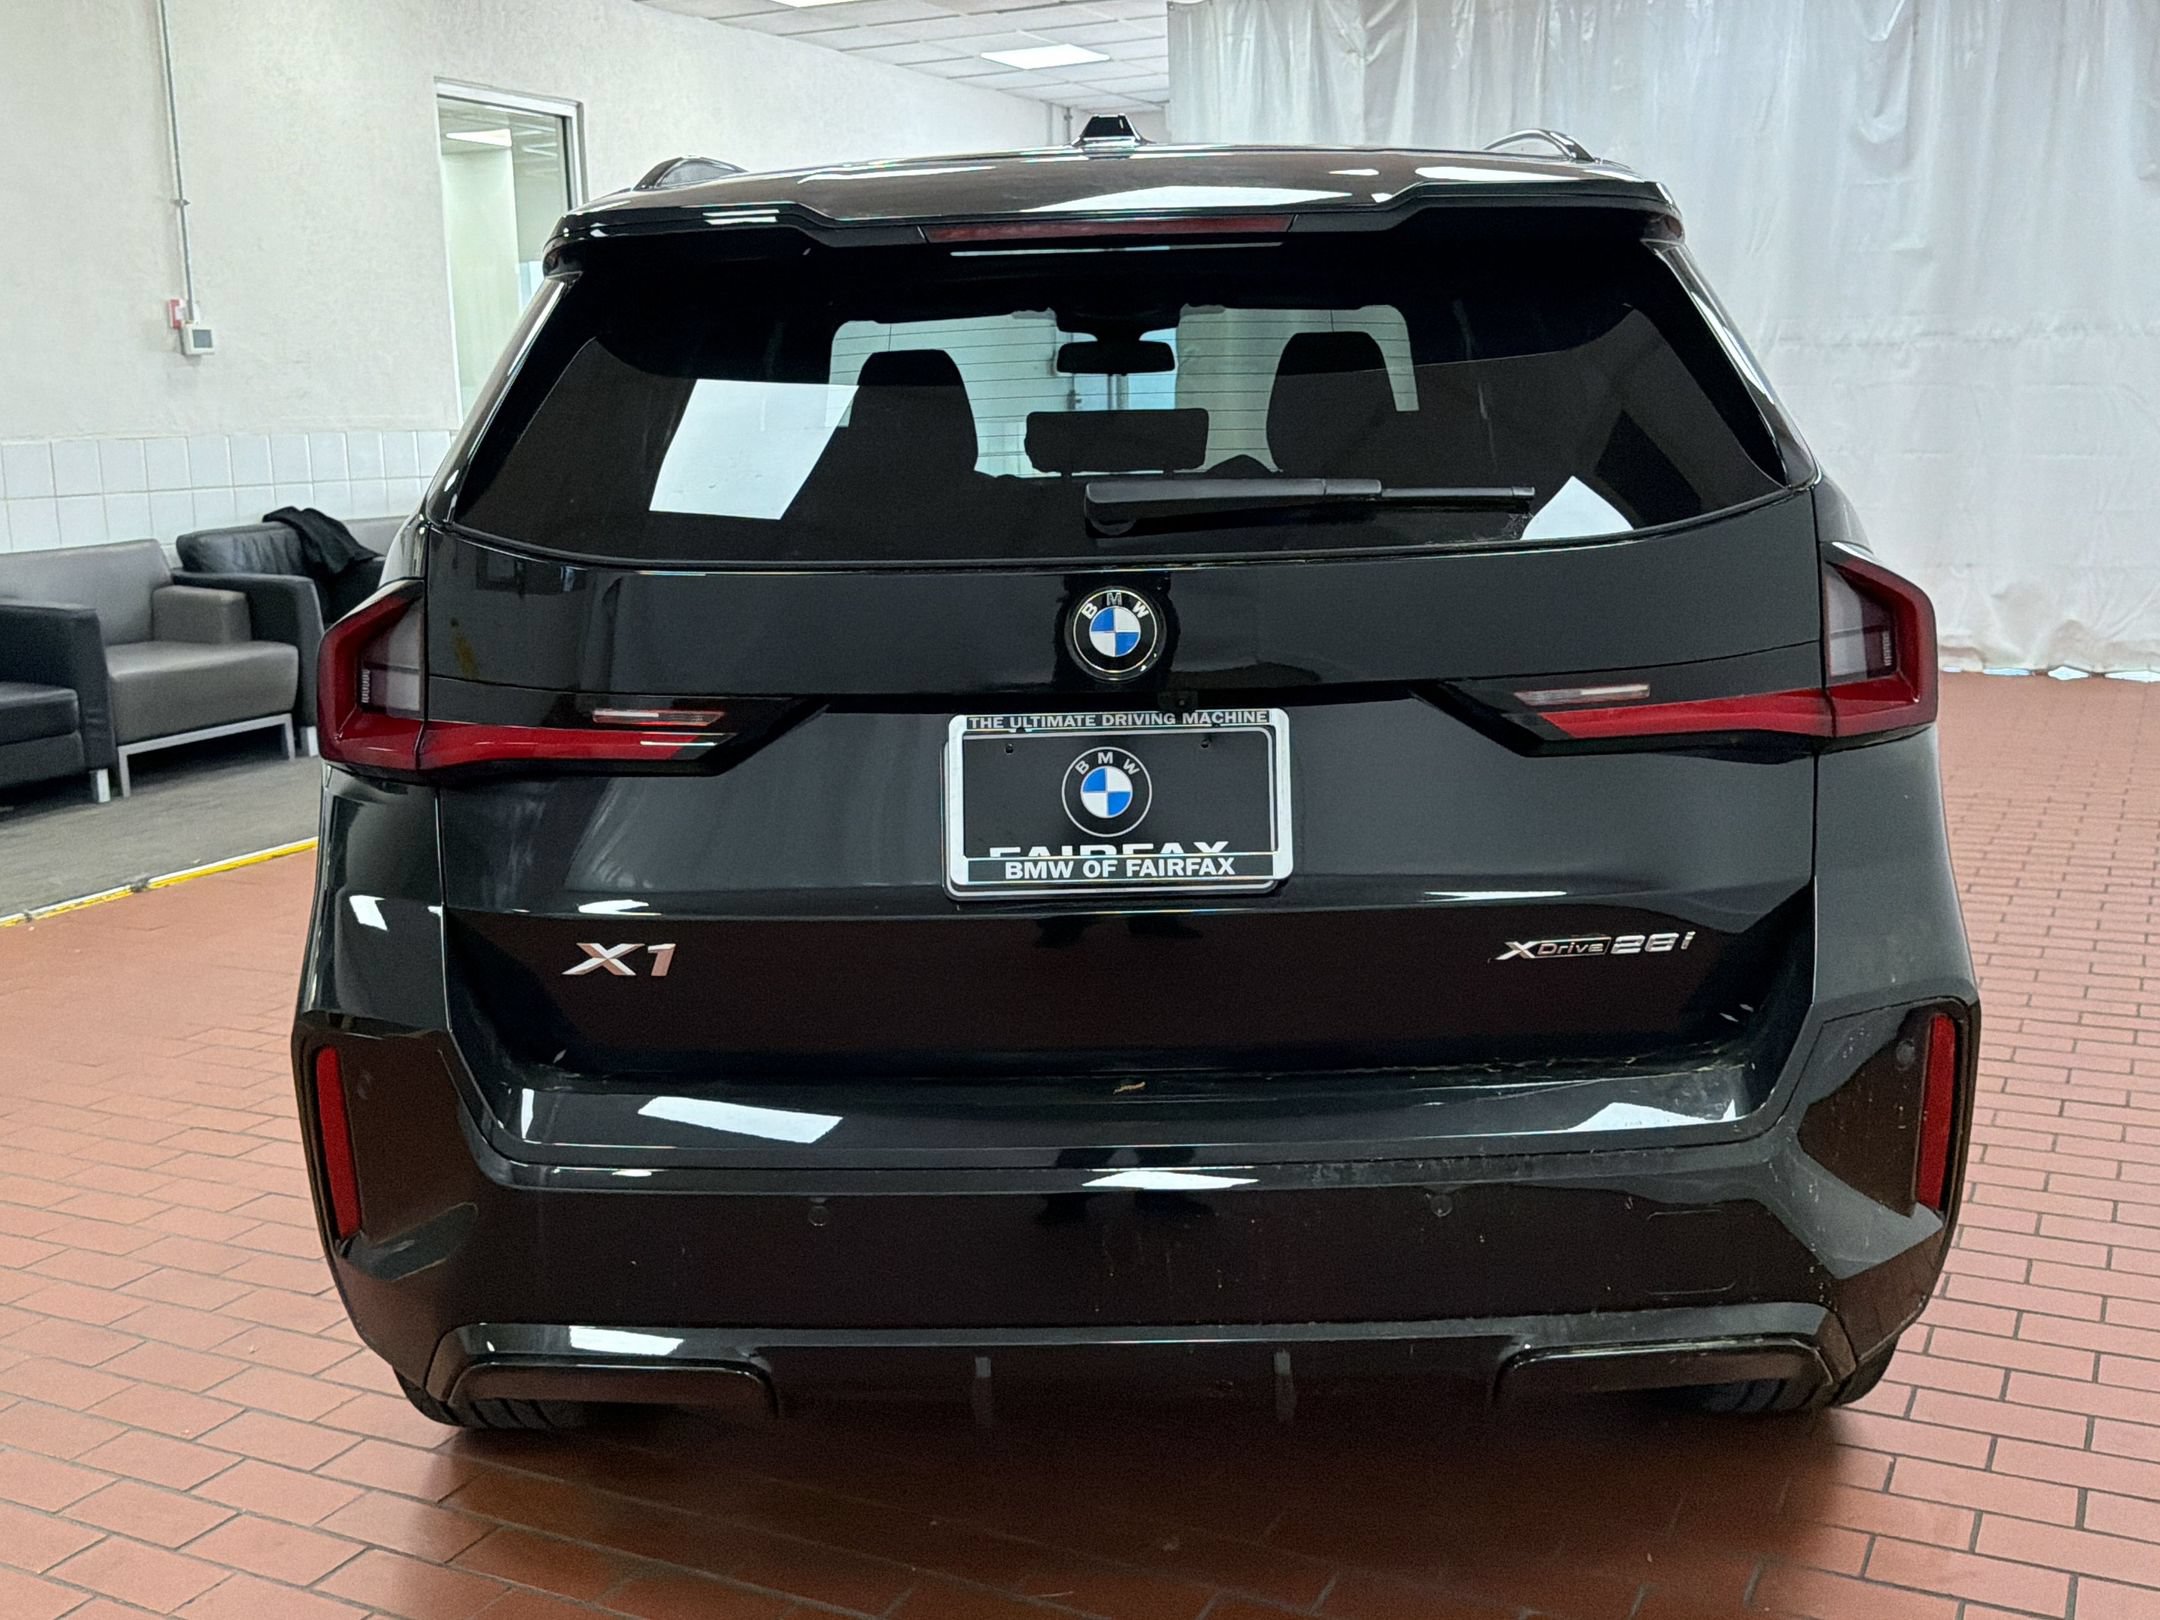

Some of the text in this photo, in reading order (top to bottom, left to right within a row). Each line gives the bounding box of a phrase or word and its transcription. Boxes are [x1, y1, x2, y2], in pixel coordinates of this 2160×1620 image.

[1081, 592, 1149, 619] BMW
[969, 710, 1268, 729] THE ULTIMATE DRIVING MACHINE
[1075, 751, 1140, 775] BMW
[1005, 857, 1236, 879] BMW OF FAIRFAX
[561, 942, 676, 977] X1
